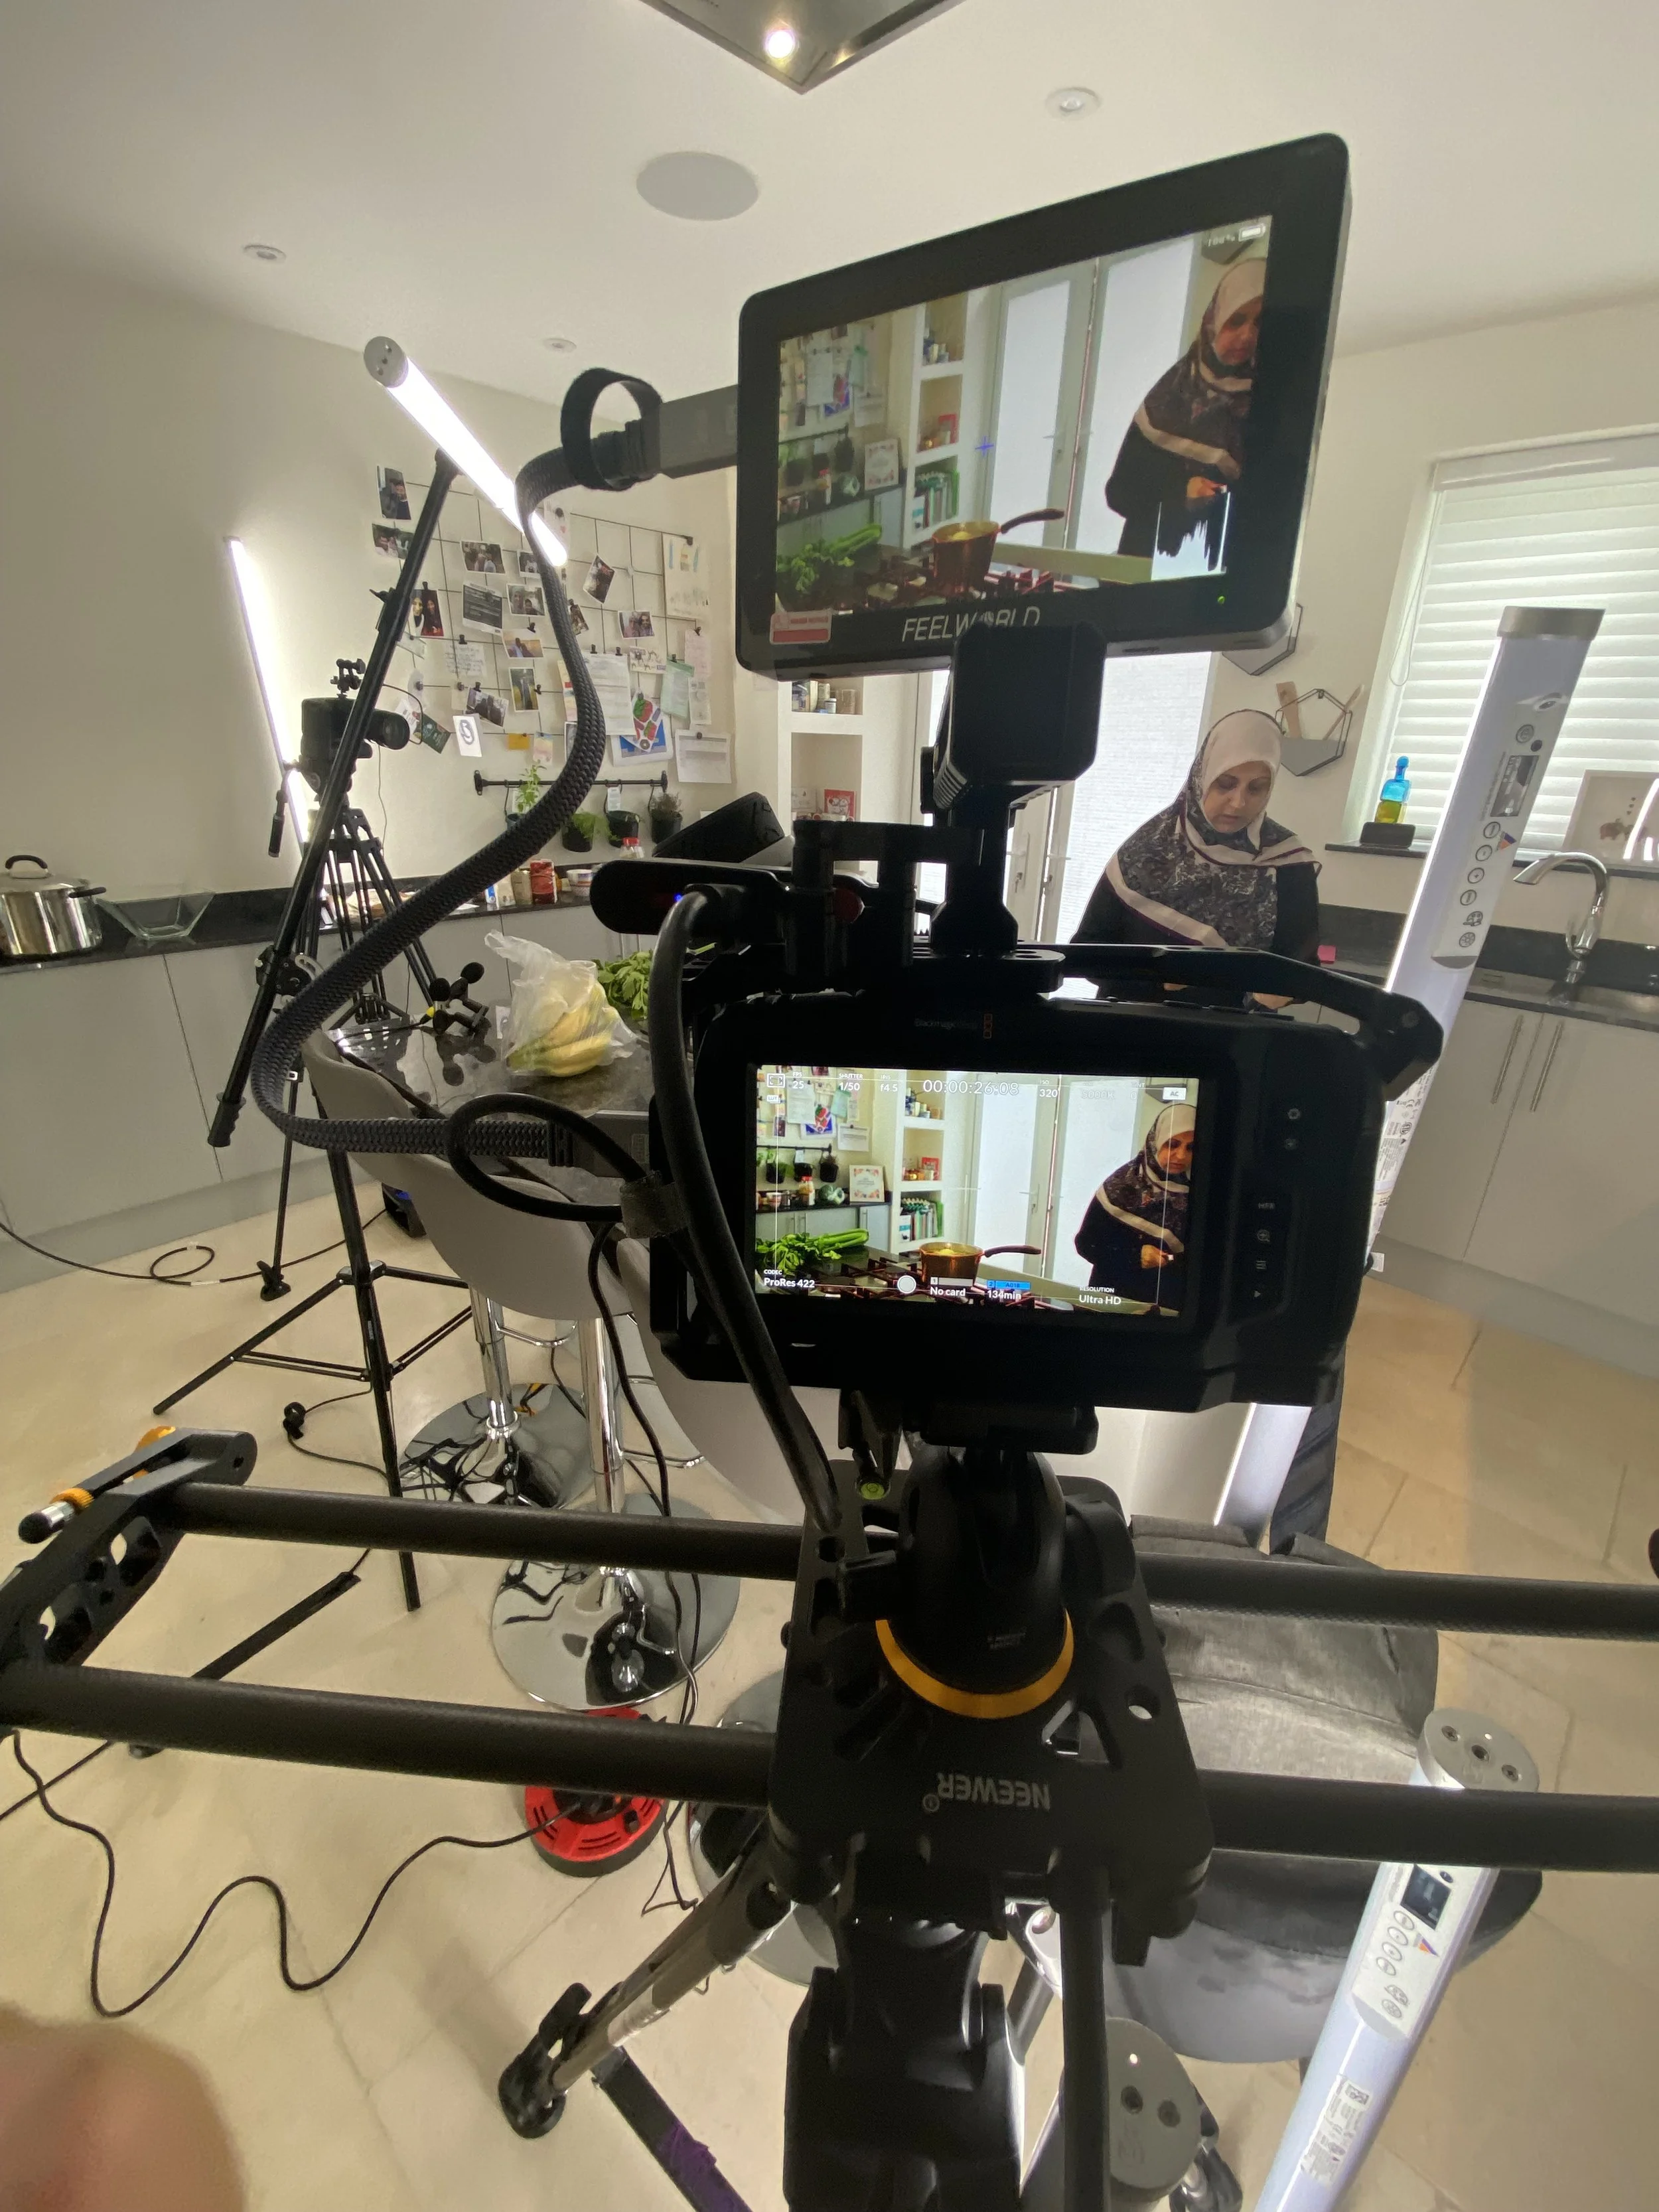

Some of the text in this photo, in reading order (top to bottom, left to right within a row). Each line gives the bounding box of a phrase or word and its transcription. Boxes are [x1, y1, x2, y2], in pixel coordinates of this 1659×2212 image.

[792, 1080, 804, 1089] 25
[839, 1082, 861, 1092] 1/50
[880, 1082, 899, 1092] f4.5
[923, 1079, 1019, 1095] 00:00:26:08
[1039, 1088, 1058, 1098] 320
[764, 1278, 815, 1288] ProRes 422
[930, 1286, 966, 1297] No card
[987, 1290, 1022, 1300] 134min
[1079, 1294, 1121, 1305] Ultra HD
[936, 1772, 1050, 1812] NEEWER
